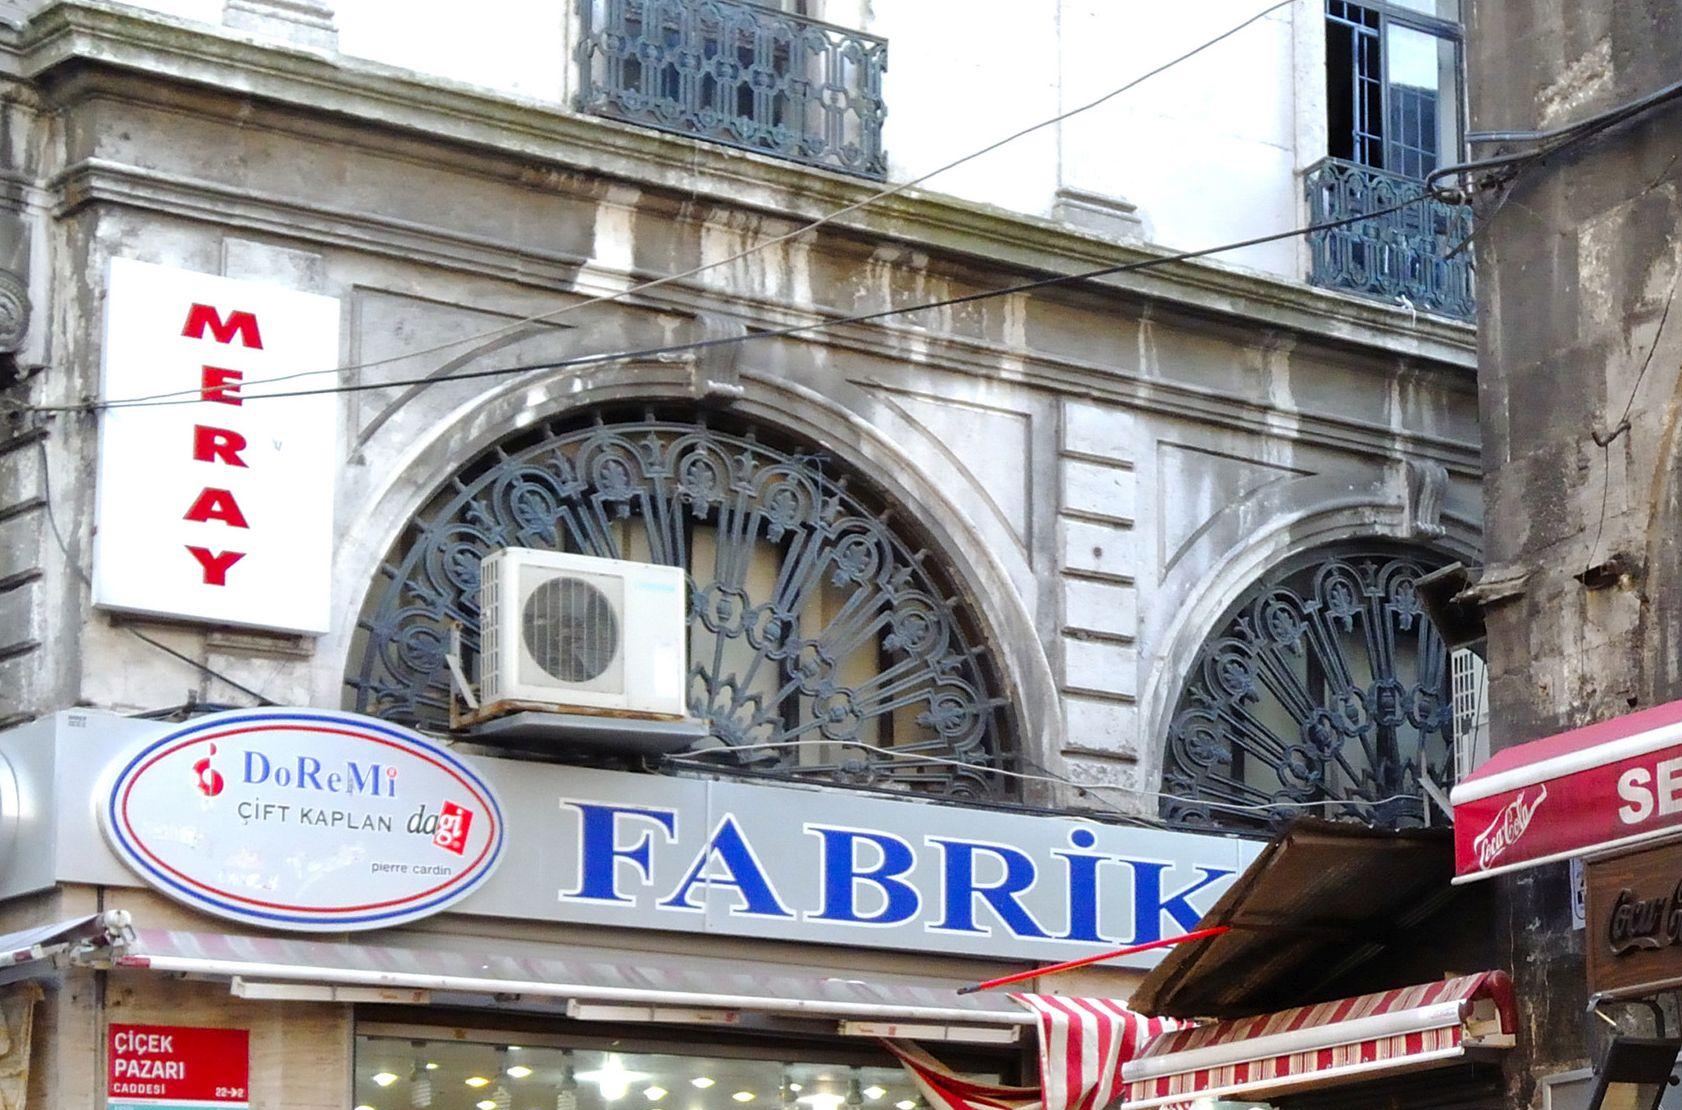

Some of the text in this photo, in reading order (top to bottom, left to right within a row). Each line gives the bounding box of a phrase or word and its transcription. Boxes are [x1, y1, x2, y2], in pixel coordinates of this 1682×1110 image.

[181, 302, 264, 588] MERAY
[237, 797, 393, 833] ÇİFT KAPLAN
[406, 804, 466, 847] dagi
[1474, 783, 1548, 871] Coca-Cola
[371, 861, 453, 877] pierre cardin
[113, 1030, 174, 1056] ÇİÇEK
[114, 1059, 185, 1080] PAZARI
[113, 1082, 166, 1095] CADDESİ
